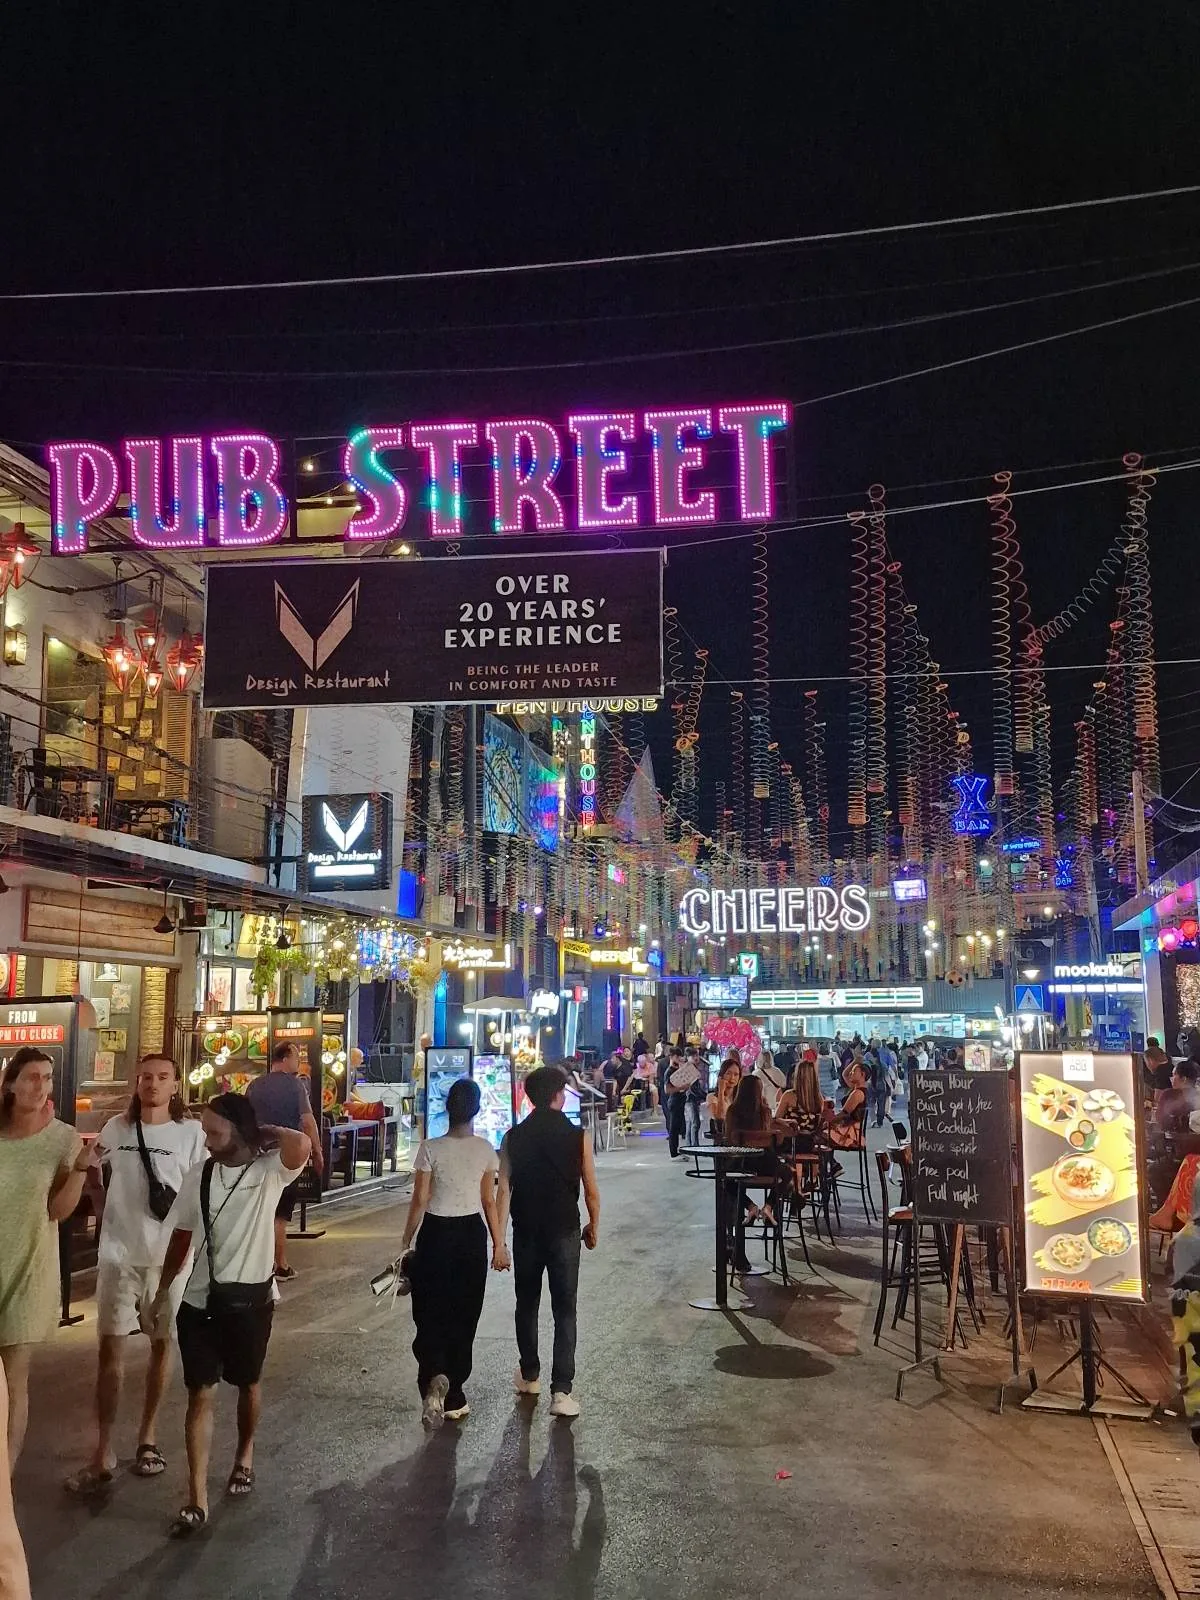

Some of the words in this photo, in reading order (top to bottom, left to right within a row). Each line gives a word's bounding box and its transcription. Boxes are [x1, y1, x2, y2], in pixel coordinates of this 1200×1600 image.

[47, 433, 289, 554] PUB
[343, 402, 790, 542] STREET
[495, 574, 570, 596] OVER
[459, 602, 494, 622] 20
[506, 597, 606, 621] YEARS'
[444, 623, 622, 649] EXPERIENCE
[467, 663, 510, 676] BEING
[515, 662, 541, 674] THE
[546, 661, 600, 674] LEADER
[246, 674, 297, 697] Design
[304, 669, 391, 690] Restaurant
[449, 680, 463, 691] IN
[469, 678, 537, 691] COMFORT
[542, 677, 571, 689] AND
[577, 675, 618, 688] TASTE
[679, 884, 871, 934] CHEERS
[1054, 961, 1124, 978] mookata
[8, 1010, 37, 1024] FROM
[15, 1029, 27, 1041] TO
[29, 1027, 59, 1040] CLOSE
[915, 1073, 945, 1100] Happy
[948, 1073, 974, 1090] Hour
[916, 1098, 938, 1117] Buy
[949, 1098, 964, 1118] get
[936, 1115, 979, 1135] Cocktail
[918, 1157, 940, 1178] Free
[946, 1159, 969, 1182] pool
[927, 1181, 947, 1203] Full
[952, 1183, 980, 1210] night
